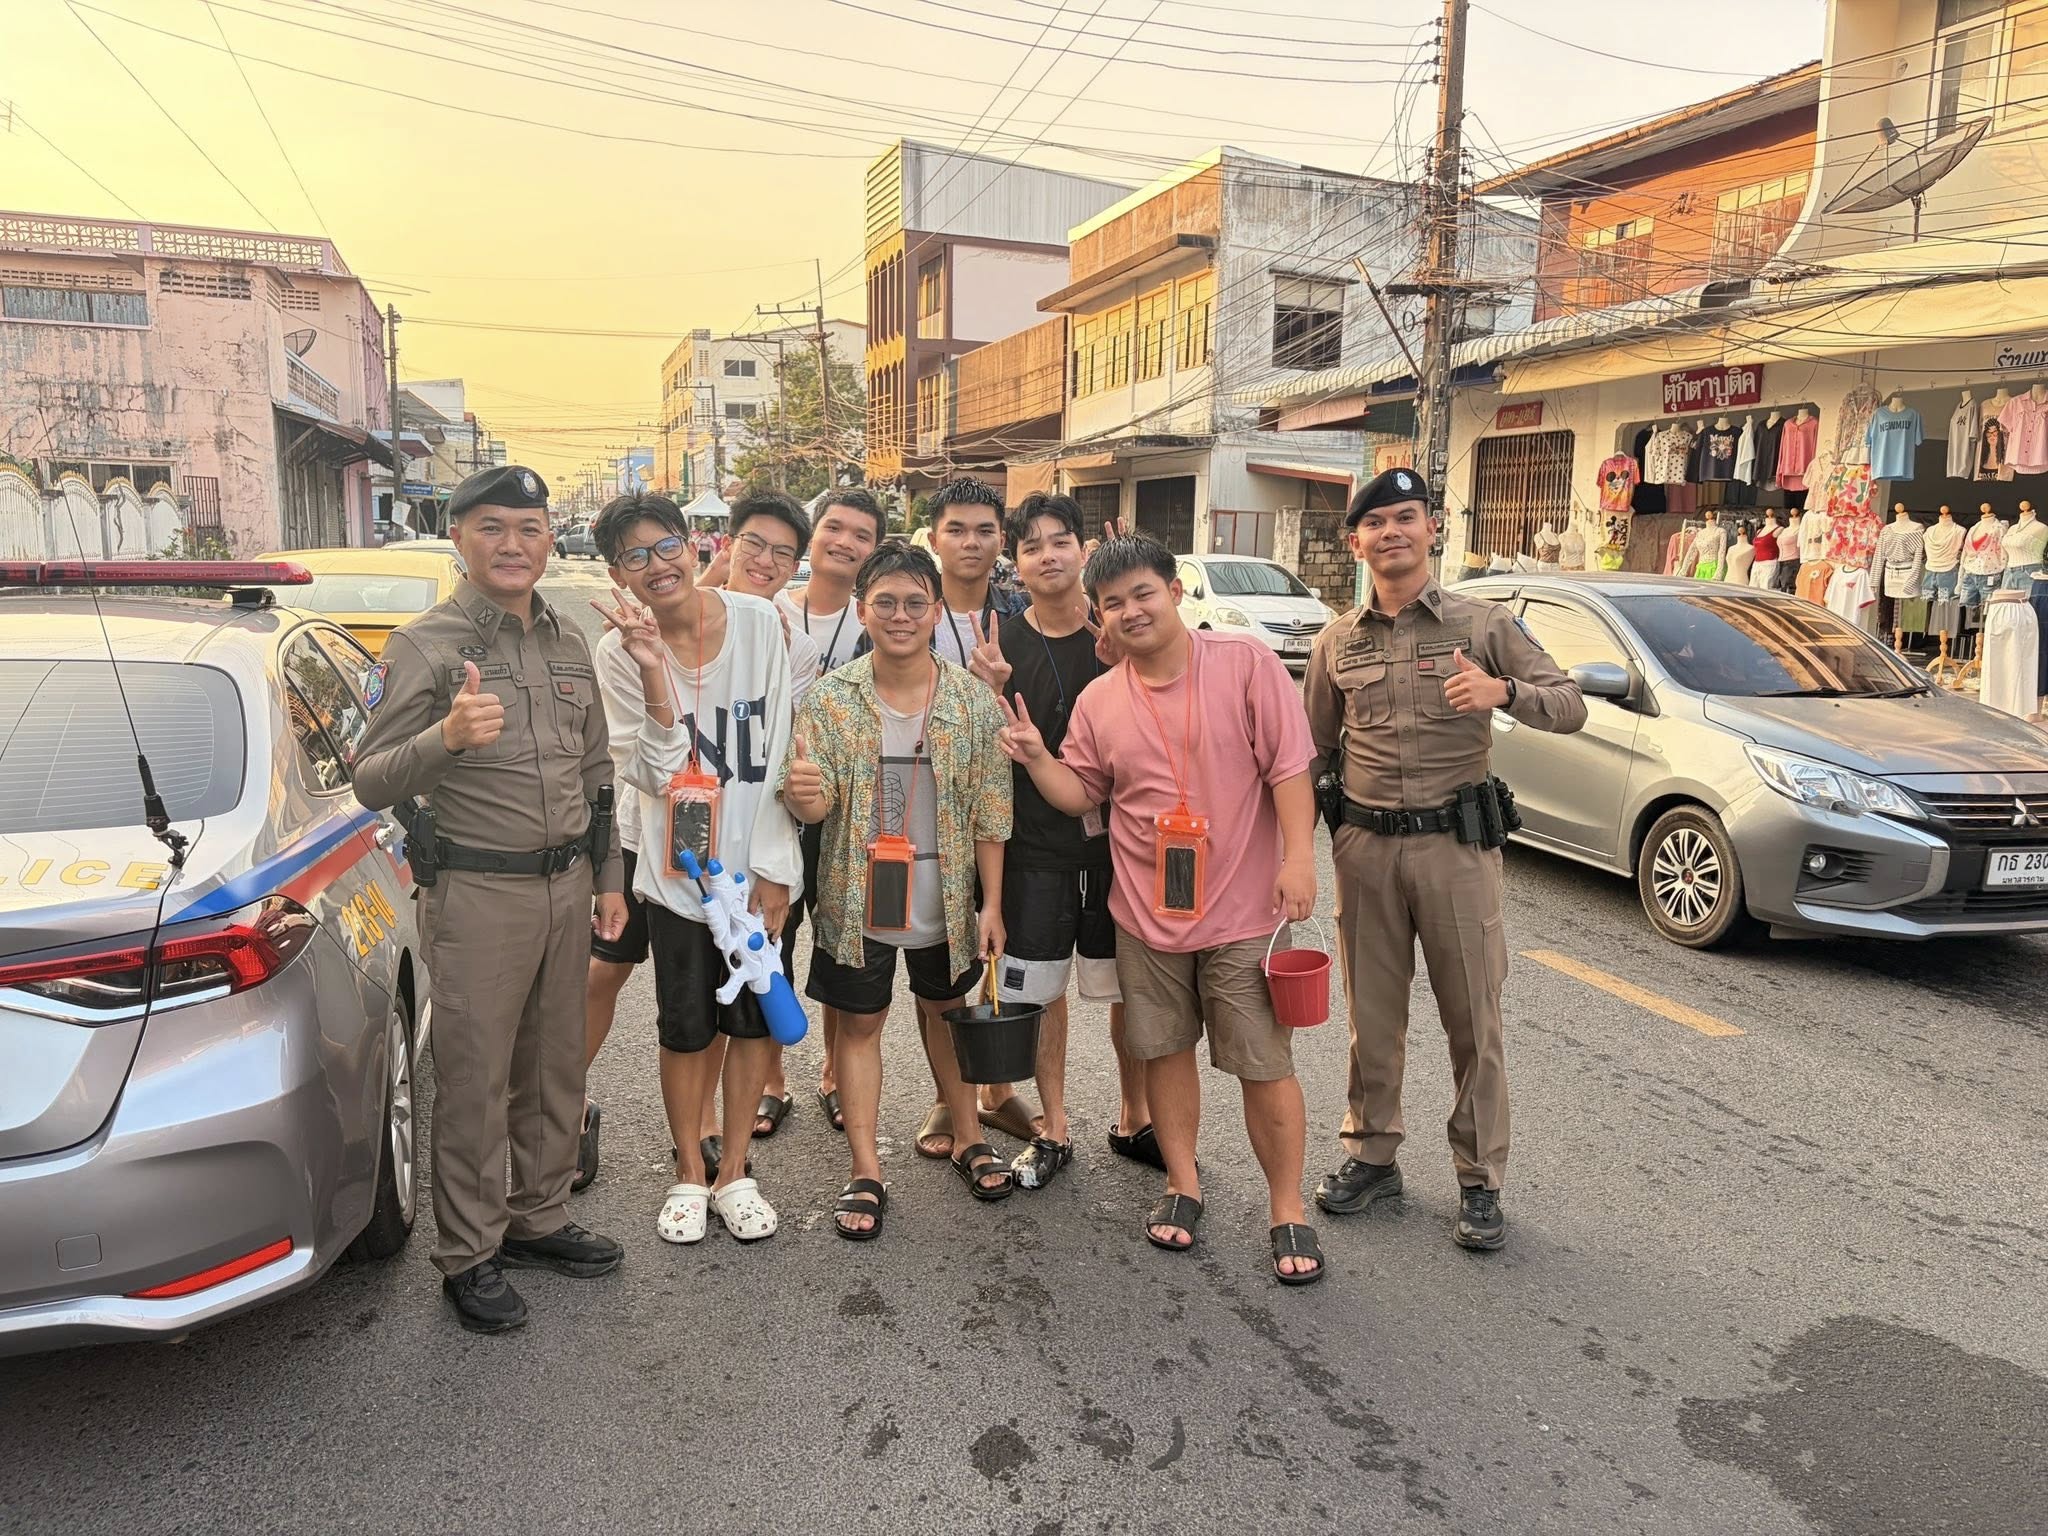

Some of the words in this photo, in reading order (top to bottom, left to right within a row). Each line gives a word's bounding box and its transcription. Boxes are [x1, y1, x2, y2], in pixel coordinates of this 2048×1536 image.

[1664, 367, 1755, 412] ตุ๊กตาบูติค
[736, 703, 745, 717] 7
[0, 858, 169, 890] ICE
[2002, 876, 2045, 884] มหาสารคาม
[341, 879, 399, 958] 213-04
